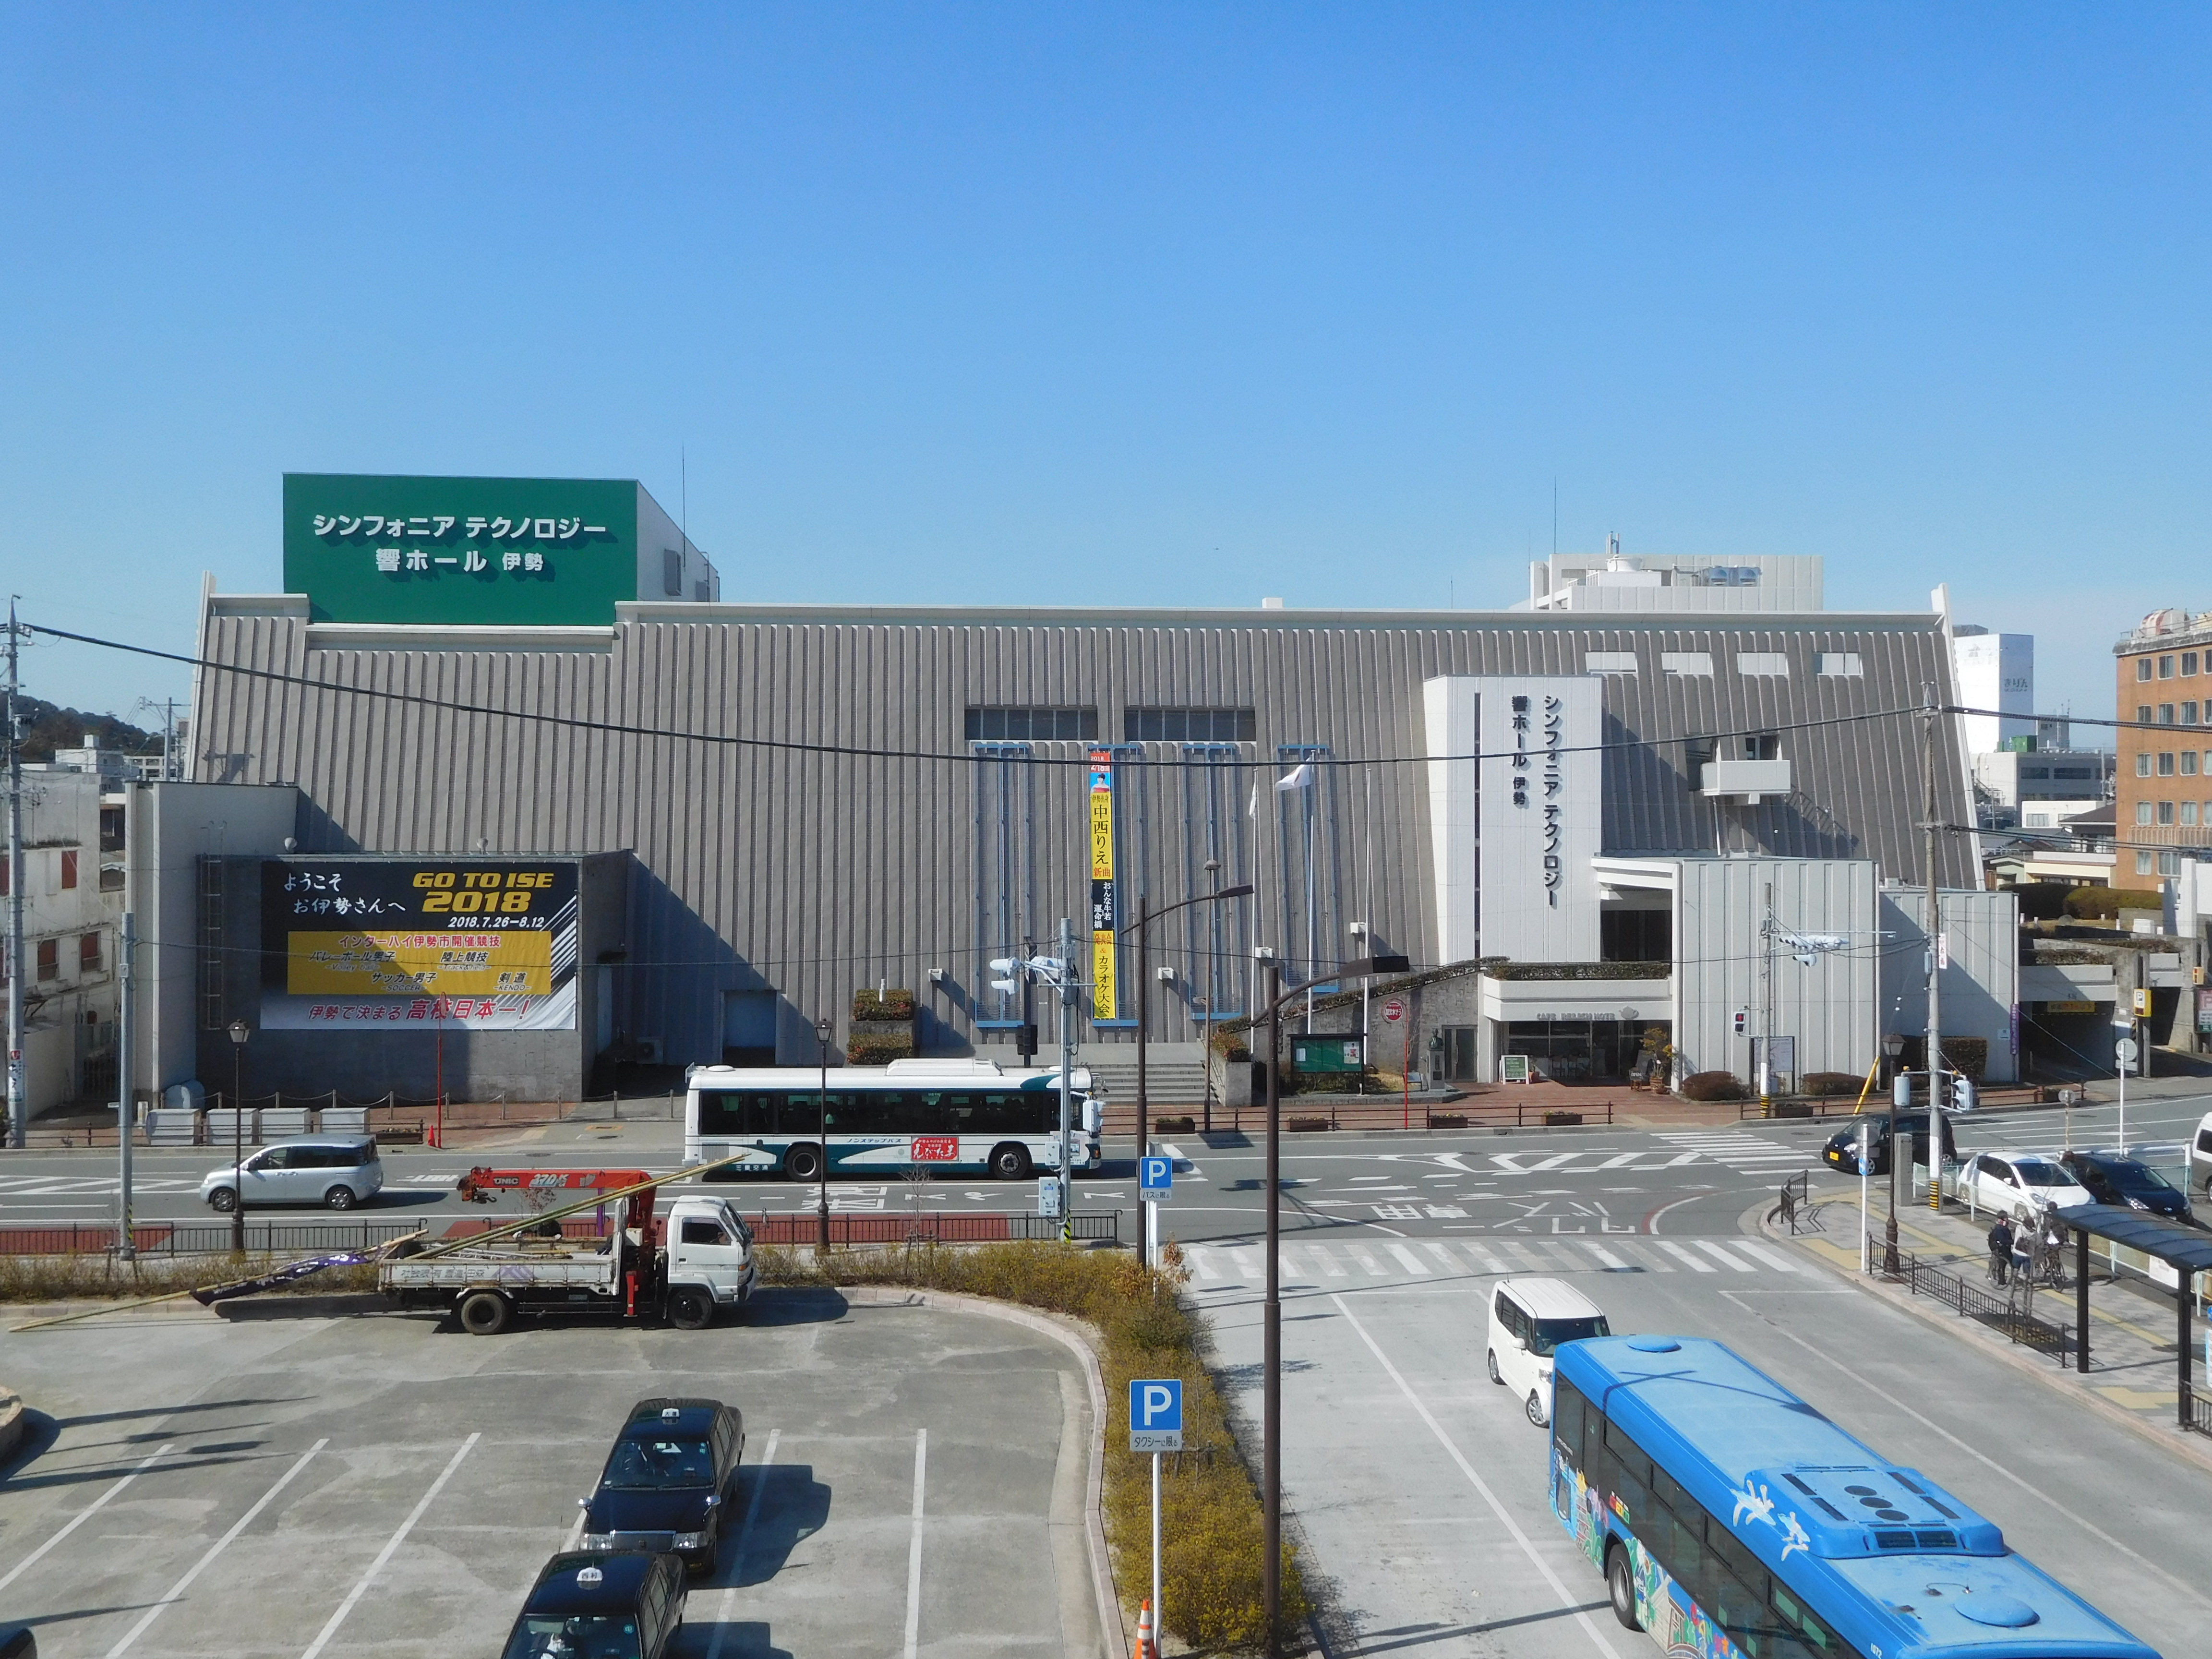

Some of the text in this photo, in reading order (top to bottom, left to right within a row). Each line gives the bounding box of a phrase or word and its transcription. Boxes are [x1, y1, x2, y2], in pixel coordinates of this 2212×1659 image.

[313, 515, 606, 539] シンフォニア テクノロジー
[376, 548, 544, 572] 響ホール 伊勢
[1512, 696, 1527, 805] 響ホール 伊勢
[1092, 794, 1109, 803] 伊勢出身
[1544, 696, 1559, 905] シンフォニア テクノロジー
[1093, 805, 1109, 864] 中西りえ
[284, 872, 342, 892] ようこそ
[413, 873, 554, 888] GO TO ISE
[1094, 867, 1110, 878] 新曲
[293, 897, 406, 914] お伊勢さんへ
[421, 891, 532, 913] 2018
[1103, 882, 1112, 921] おんな牛若
[1094, 904, 1103, 929] 運命橋
[339, 935, 501, 948] インターハイ伊勢市開催競技
[309, 950, 396, 962] バレーボール男子
[440, 951, 489, 963] 陸上競技
[372, 972, 437, 984] サッカー男子
[1098, 955, 1110, 1014] カラオケ大会
[1149, 1160, 1166, 1186] P
[1144, 1385, 1172, 1426] P
[1134, 1435, 1178, 1448] タクシーに限る
